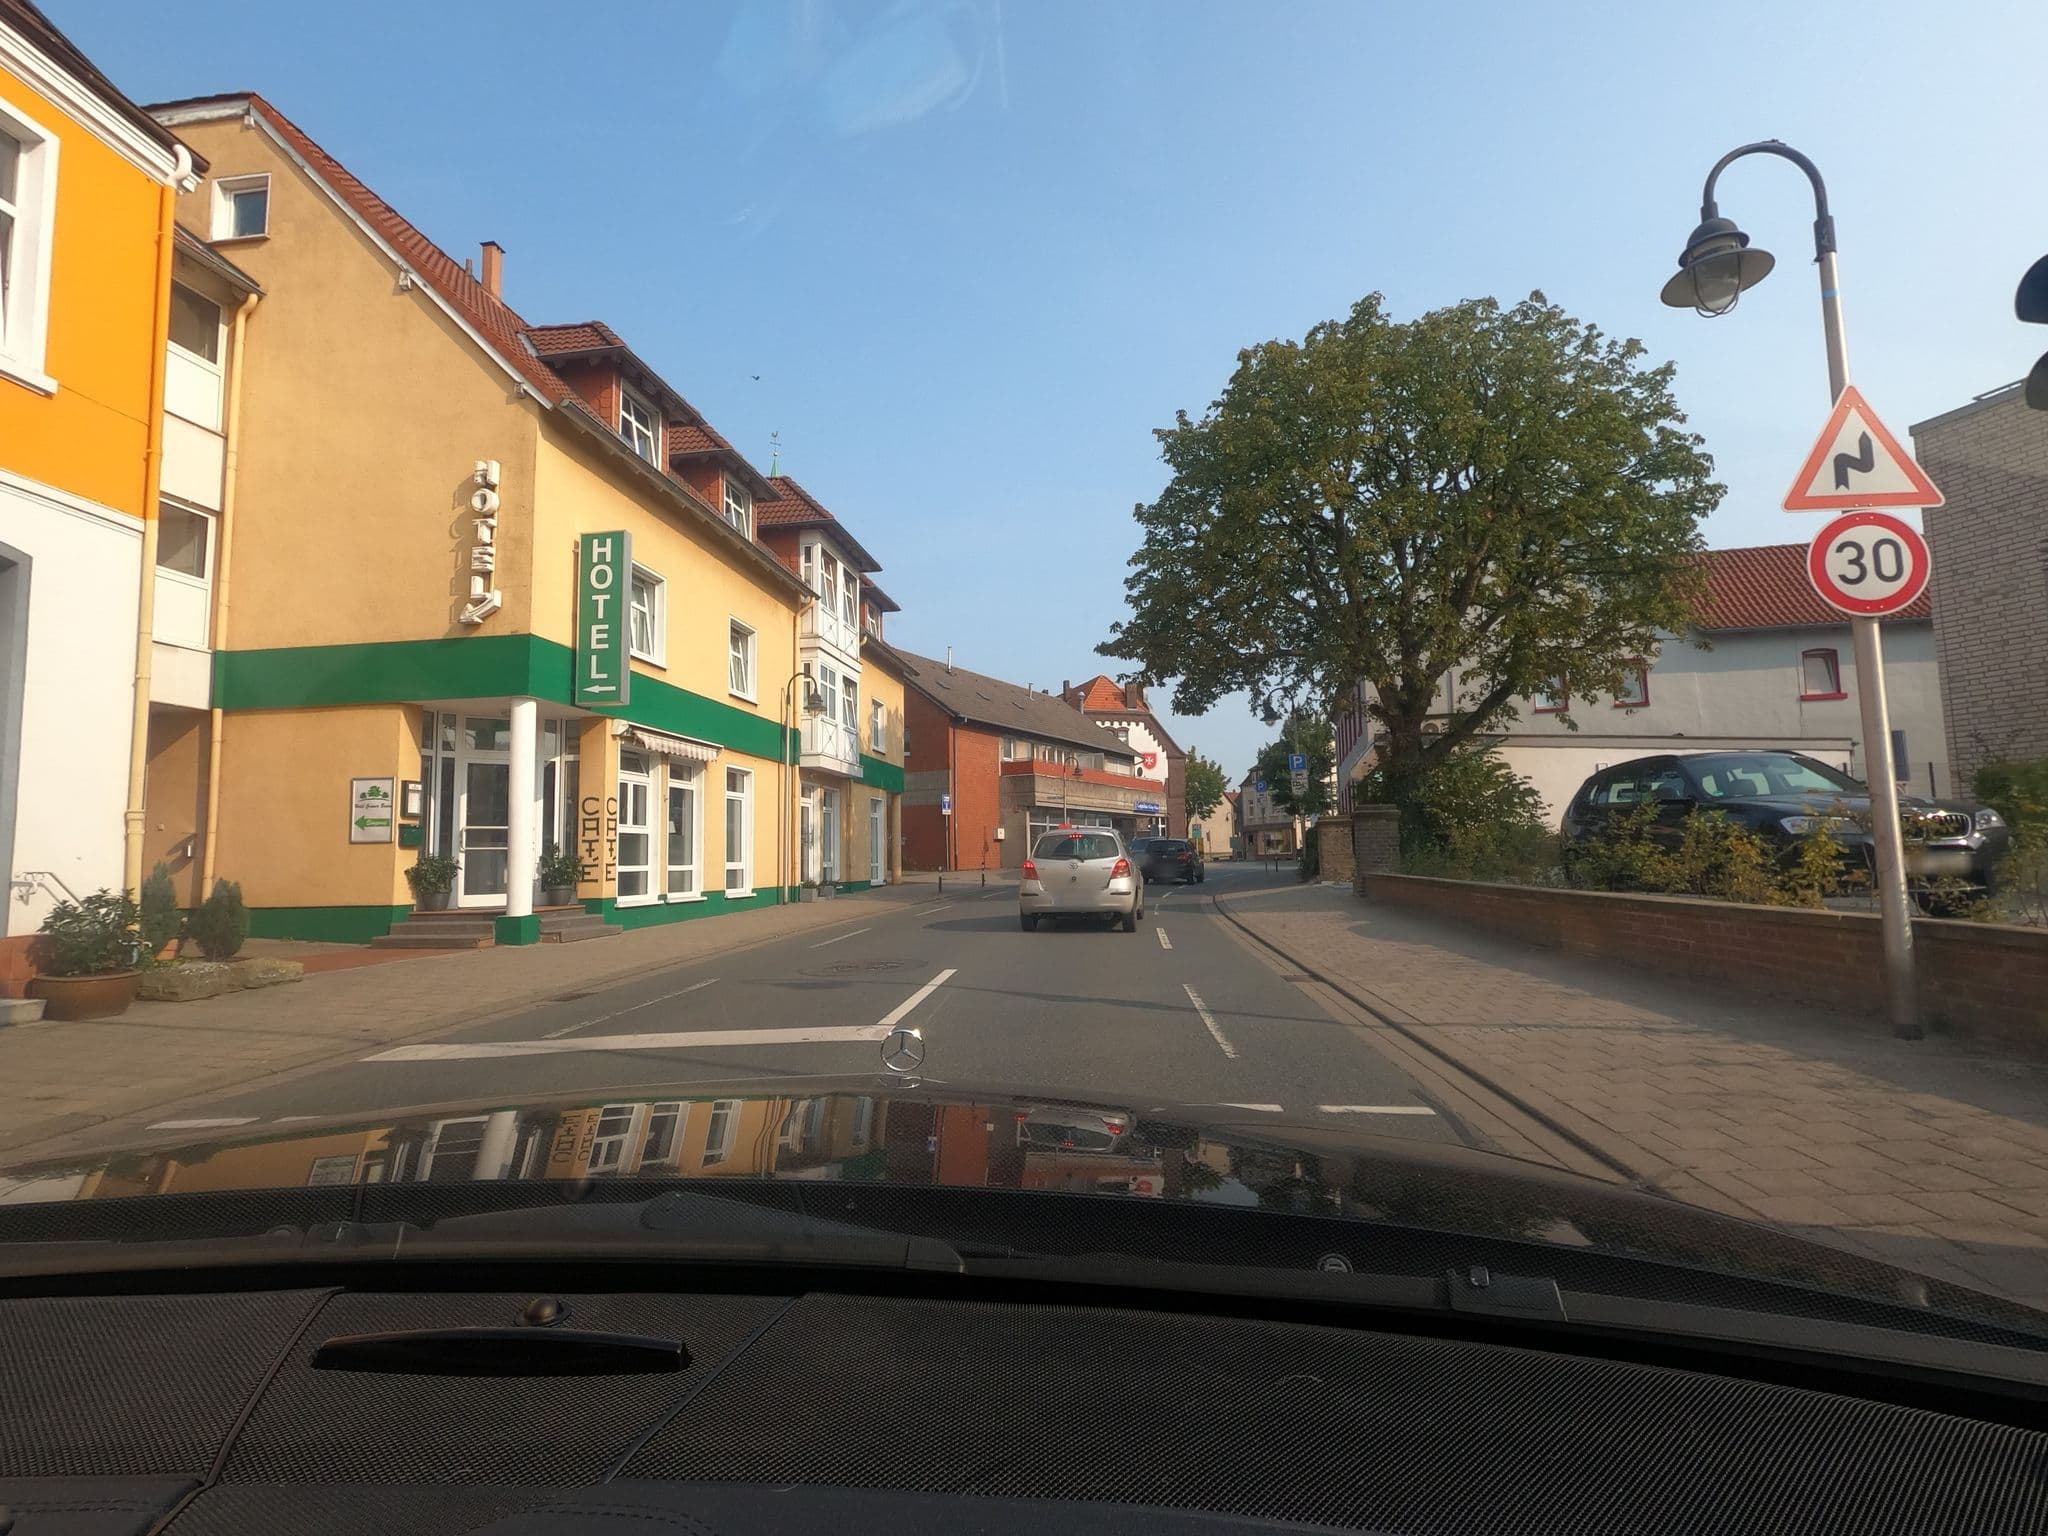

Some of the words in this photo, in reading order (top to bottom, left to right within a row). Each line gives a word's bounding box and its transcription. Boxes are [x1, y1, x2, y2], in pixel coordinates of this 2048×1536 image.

[471, 460, 500, 599] HOTEL
[1836, 538, 1904, 585] 30
[590, 537, 613, 679] HOTEL
